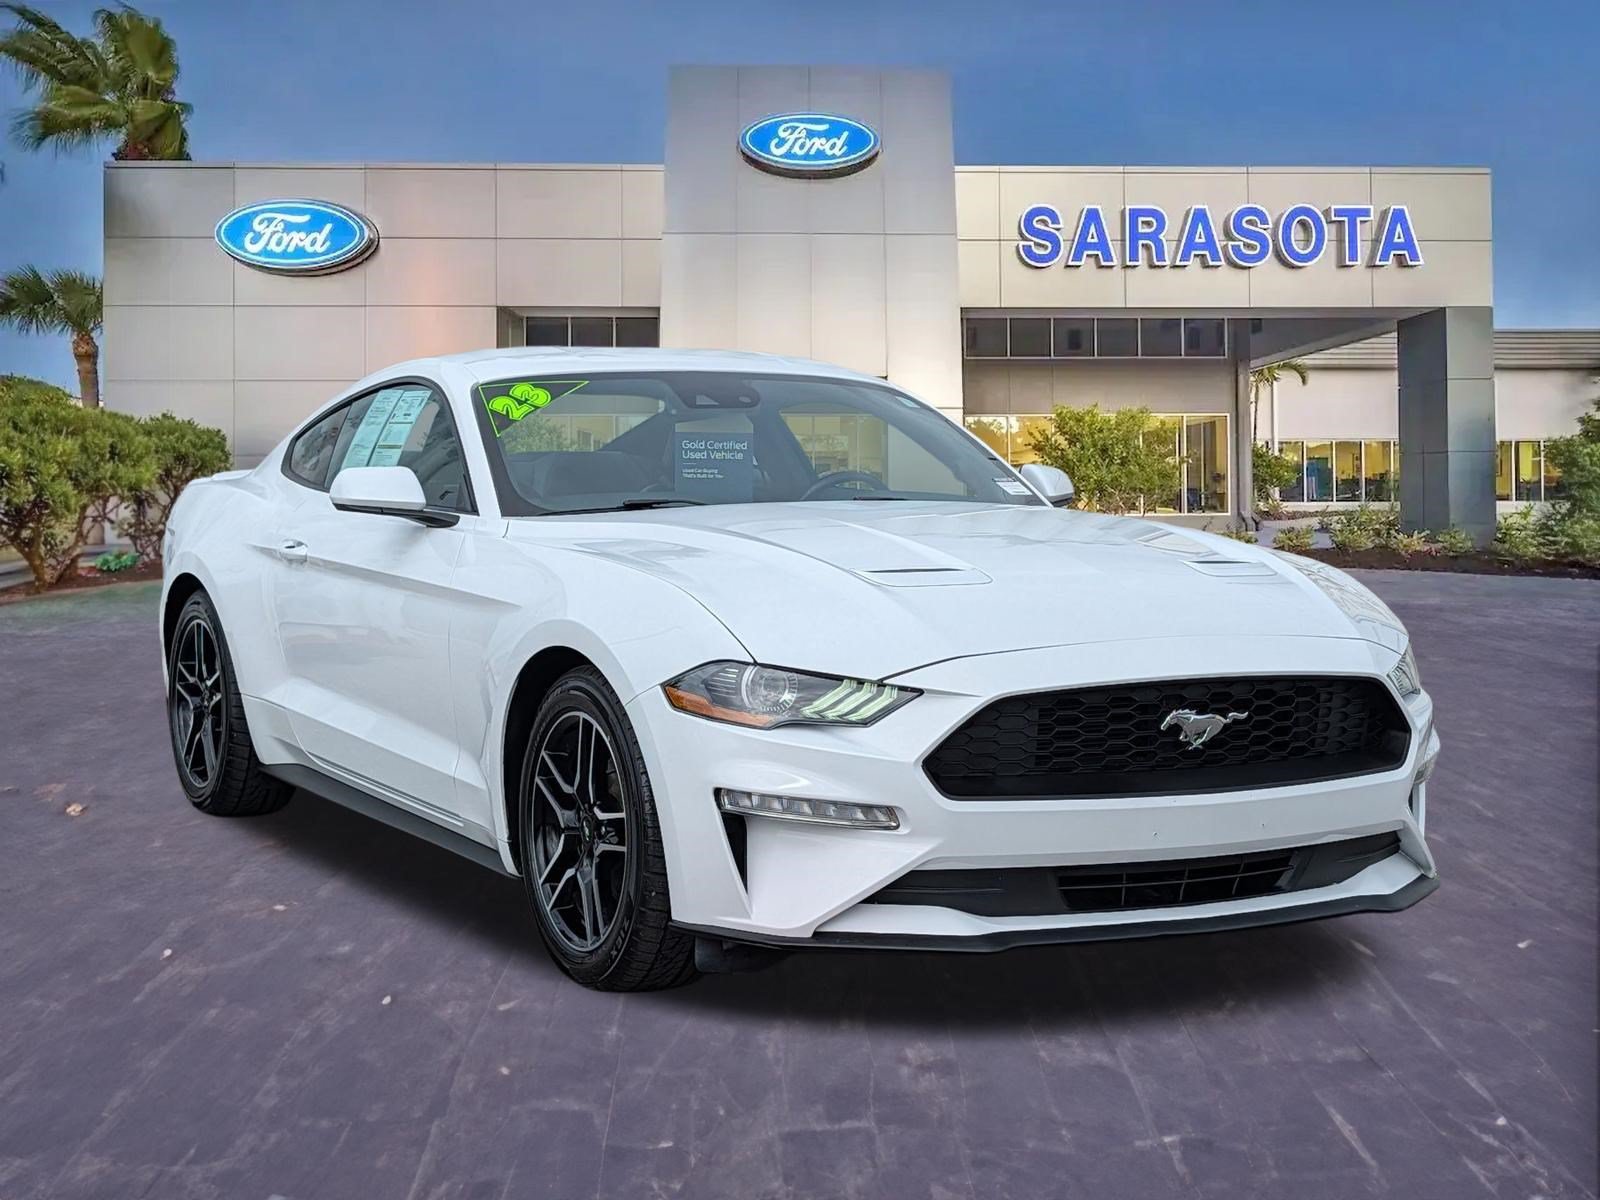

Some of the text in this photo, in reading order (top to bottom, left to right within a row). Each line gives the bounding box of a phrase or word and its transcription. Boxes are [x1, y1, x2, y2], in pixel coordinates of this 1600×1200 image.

[770, 122, 849, 157] Ford
[244, 212, 333, 253] Ford
[1018, 203, 1425, 268] SARASOTA
[489, 384, 552, 421] 23
[682, 440, 748, 450] Gold Certified
[682, 450, 744, 460] Used Vehicle
